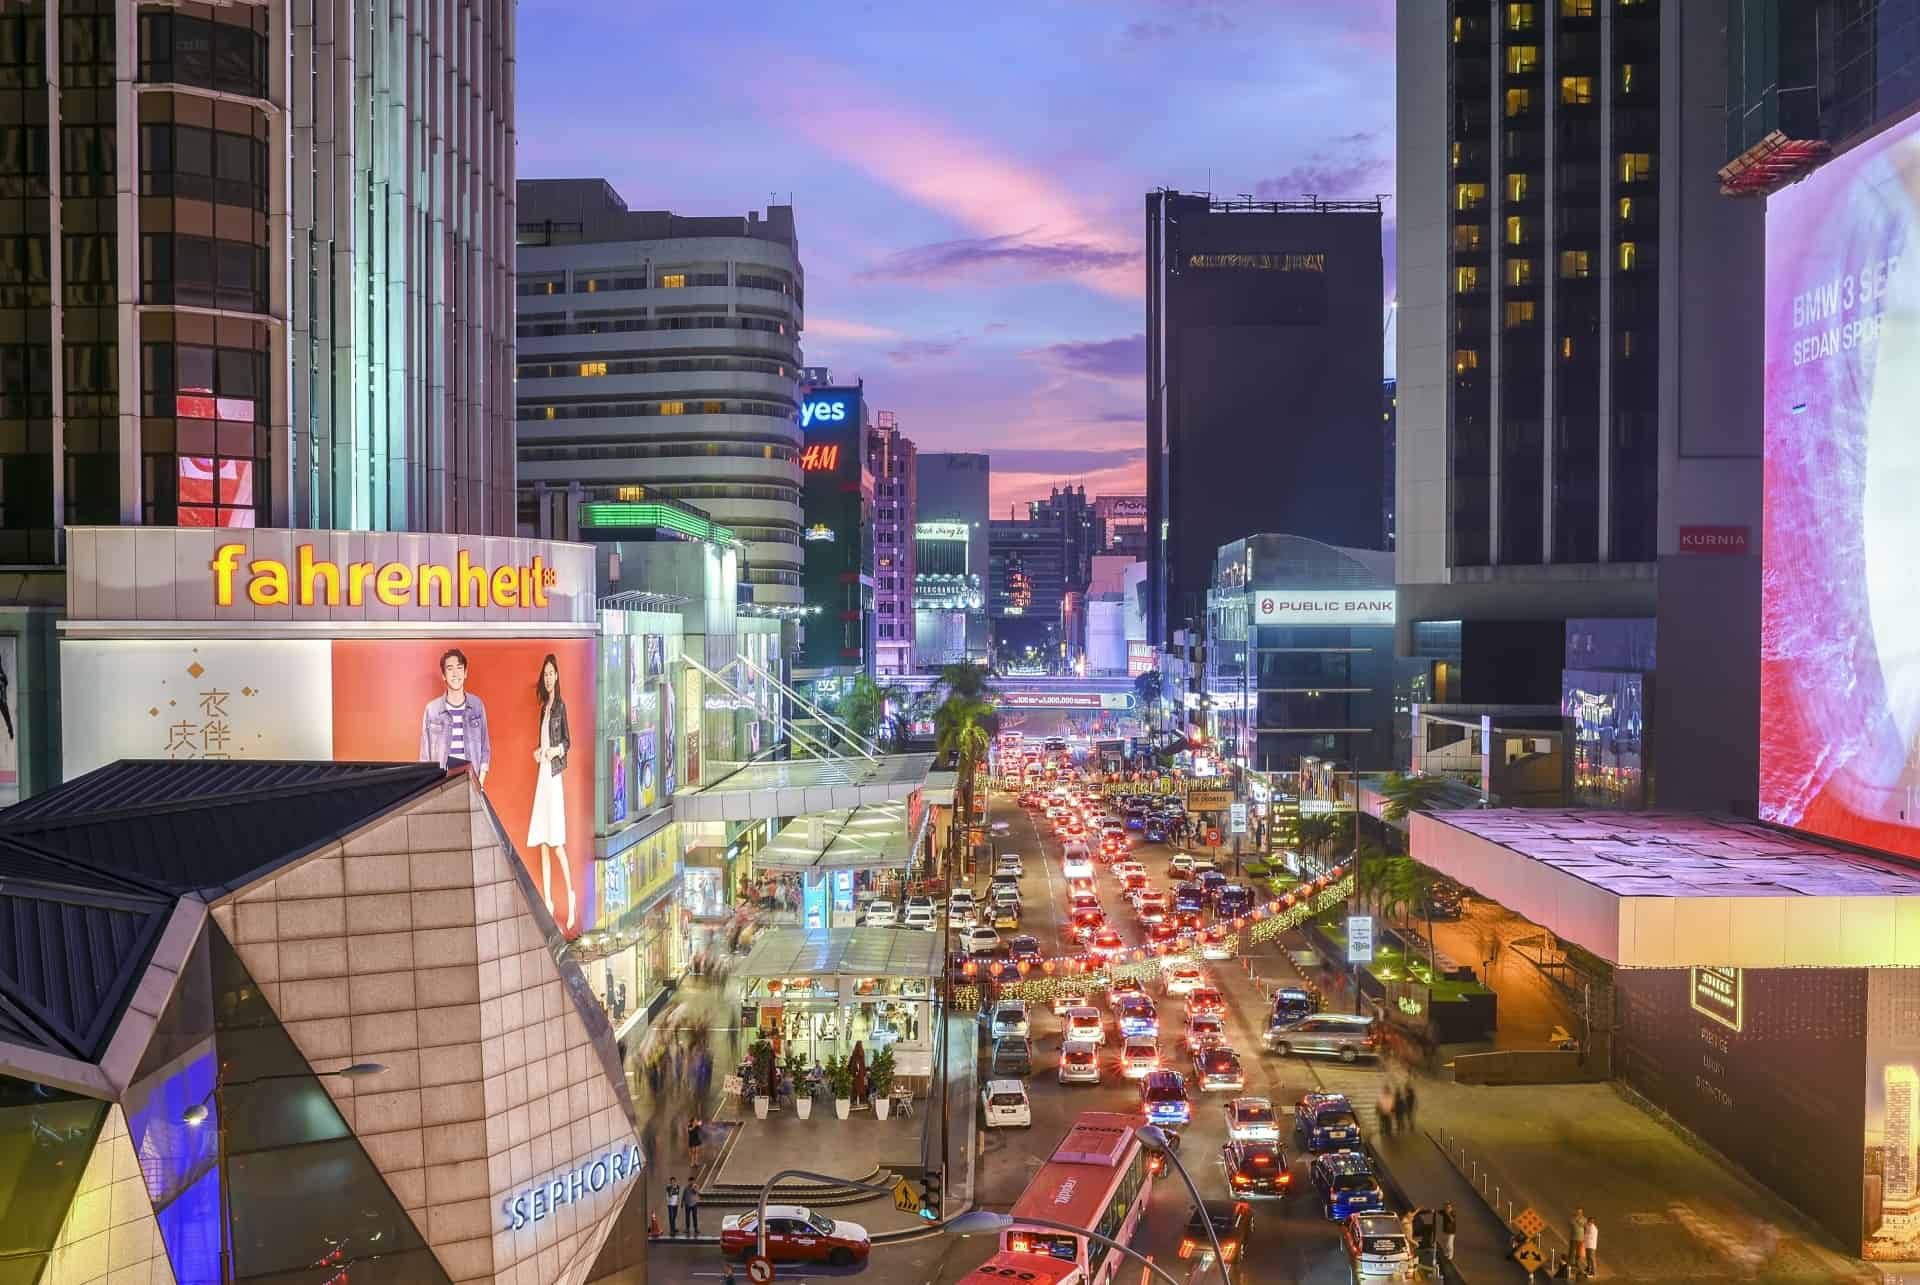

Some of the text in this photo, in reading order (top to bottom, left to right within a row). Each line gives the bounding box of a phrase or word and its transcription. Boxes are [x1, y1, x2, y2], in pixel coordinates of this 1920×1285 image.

[1793, 280, 1839, 328] BMW
[1842, 274, 1854, 310] 3
[1793, 327, 1840, 367] SEDAN
[801, 401, 845, 427] yes
[1682, 535, 1745, 545] KURNIA
[212, 543, 549, 608] fahrenheit
[1279, 600, 1393, 611] PUBLIC BANK
[511, 1144, 642, 1231] SEPHORA
